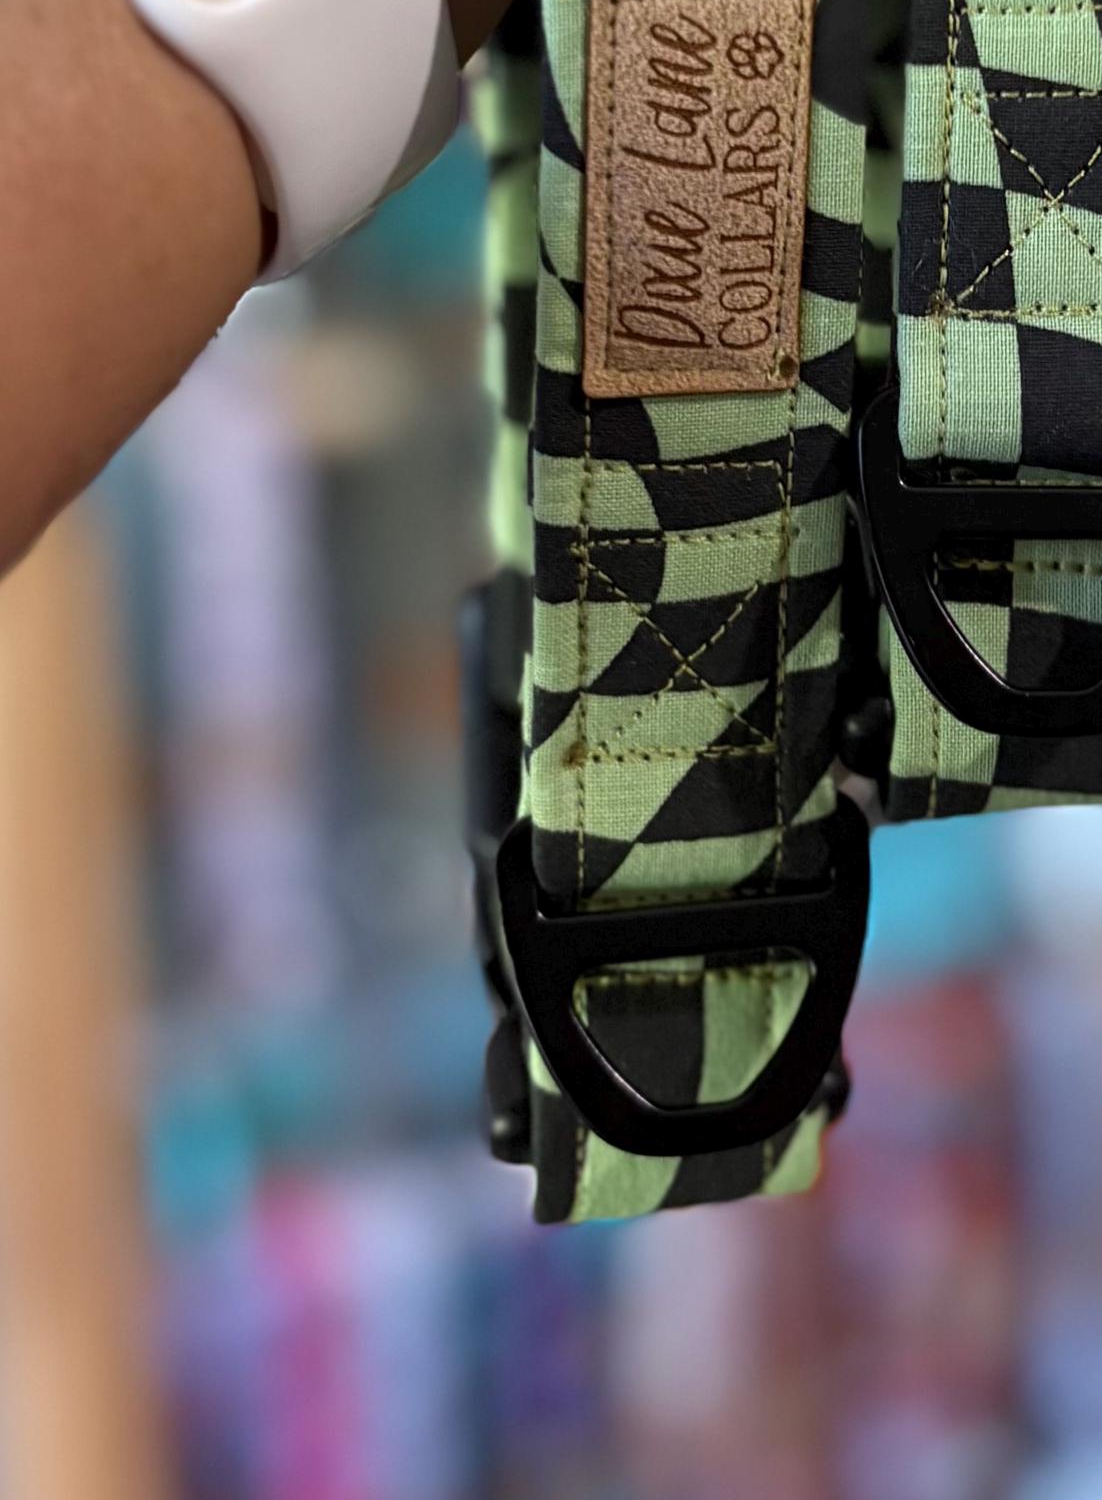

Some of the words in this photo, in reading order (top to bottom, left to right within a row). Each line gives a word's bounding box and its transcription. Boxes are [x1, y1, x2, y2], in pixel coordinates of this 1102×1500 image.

[621, 13, 718, 172] Lane
[614, 201, 713, 350] Dixie
[717, 105, 781, 351] COLLARS
